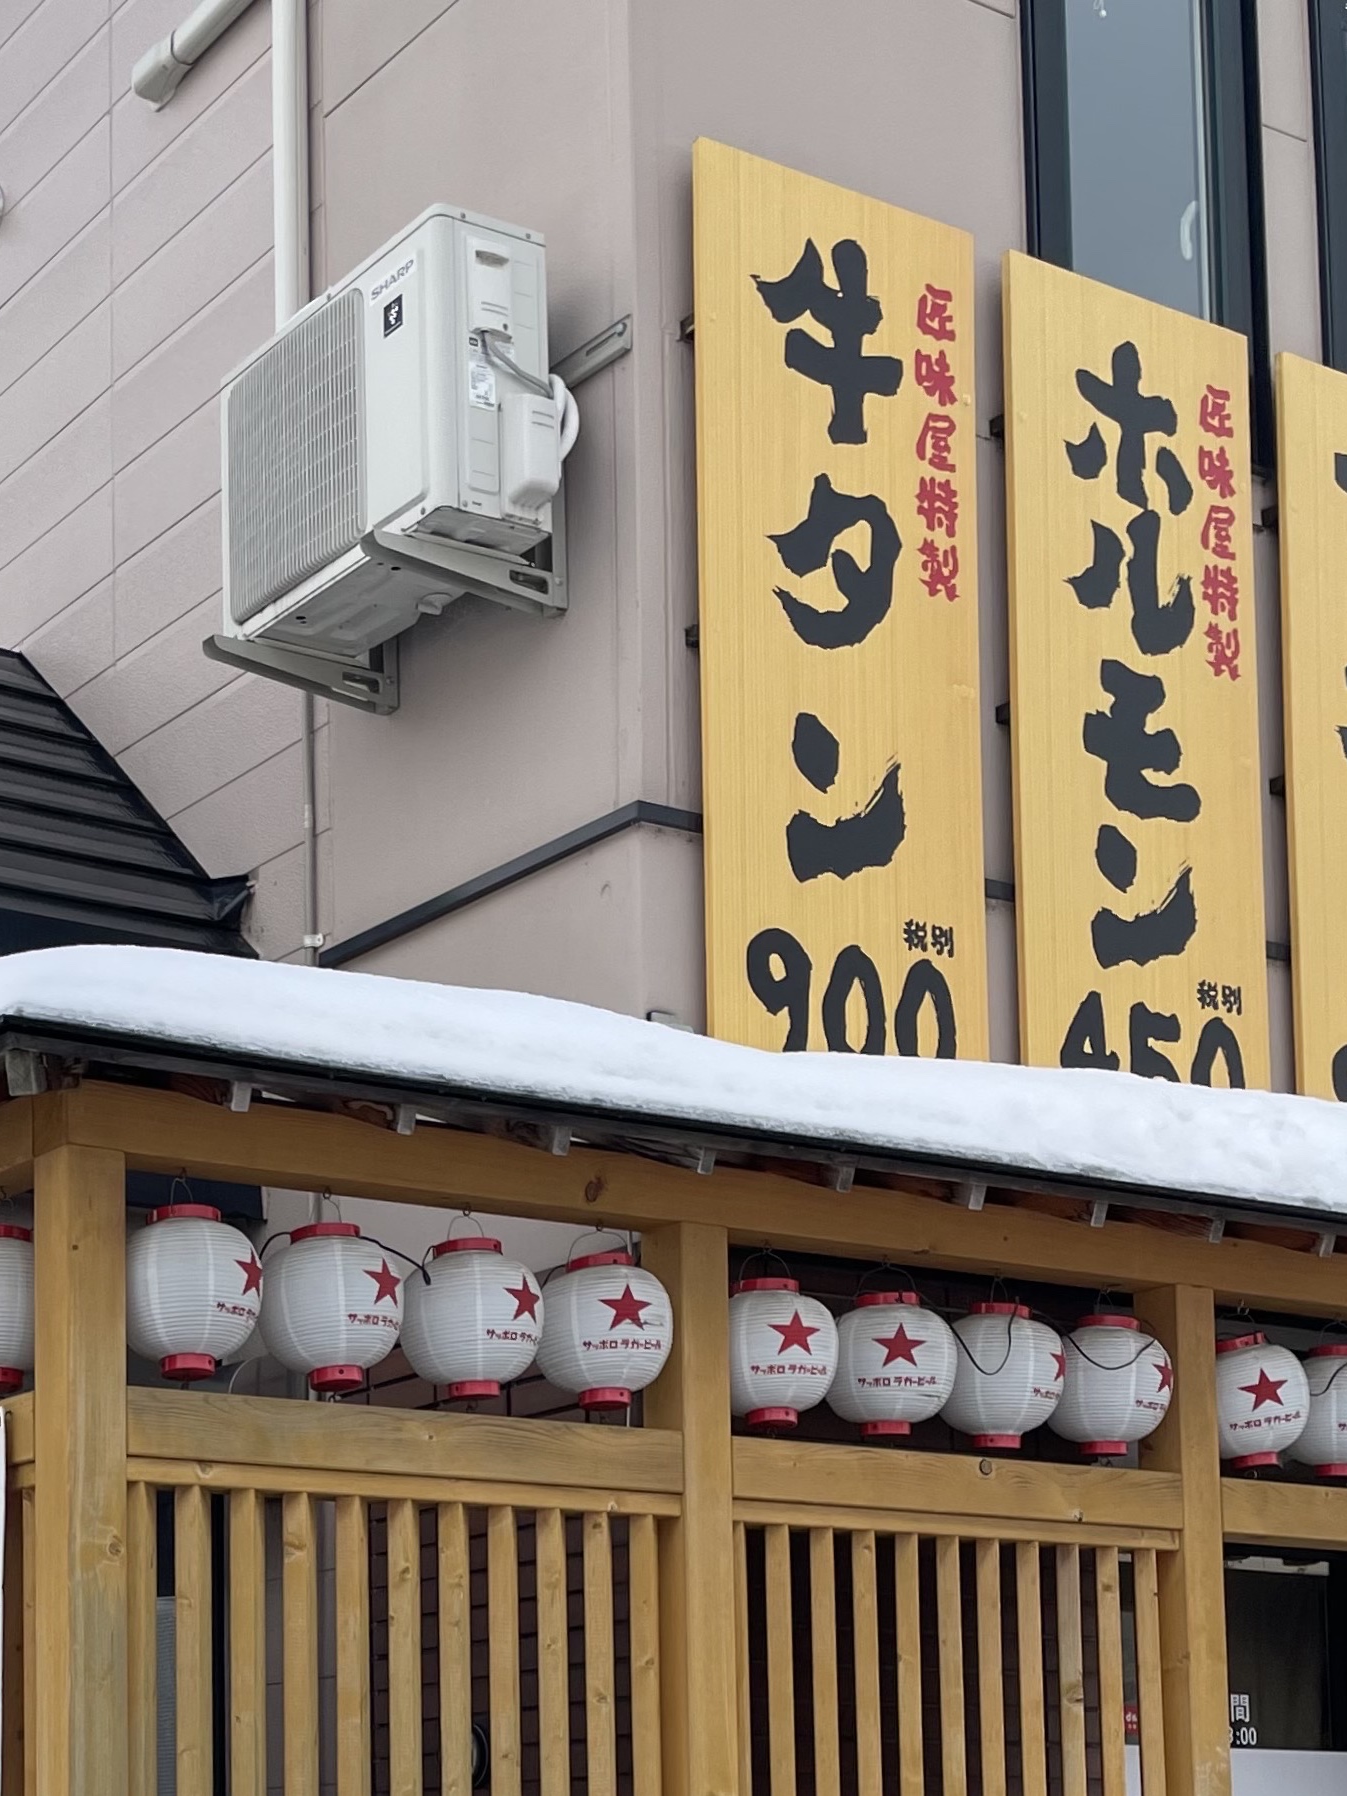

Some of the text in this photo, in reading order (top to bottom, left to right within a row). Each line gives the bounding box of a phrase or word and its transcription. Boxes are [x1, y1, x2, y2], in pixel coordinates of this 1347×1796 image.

[371, 259, 414, 301] SHARP
[915, 283, 960, 602] 匠味屋特製
[751, 236, 906, 883] 牛タン
[1197, 384, 1242, 682] 匠味屋特製
[1063, 340, 1202, 969] ホルモン
[747, 927, 957, 1060] 900
[903, 918, 955, 958] 税別
[1197, 979, 1243, 1016] 税別
[1059, 990, 1246, 1090] 450
